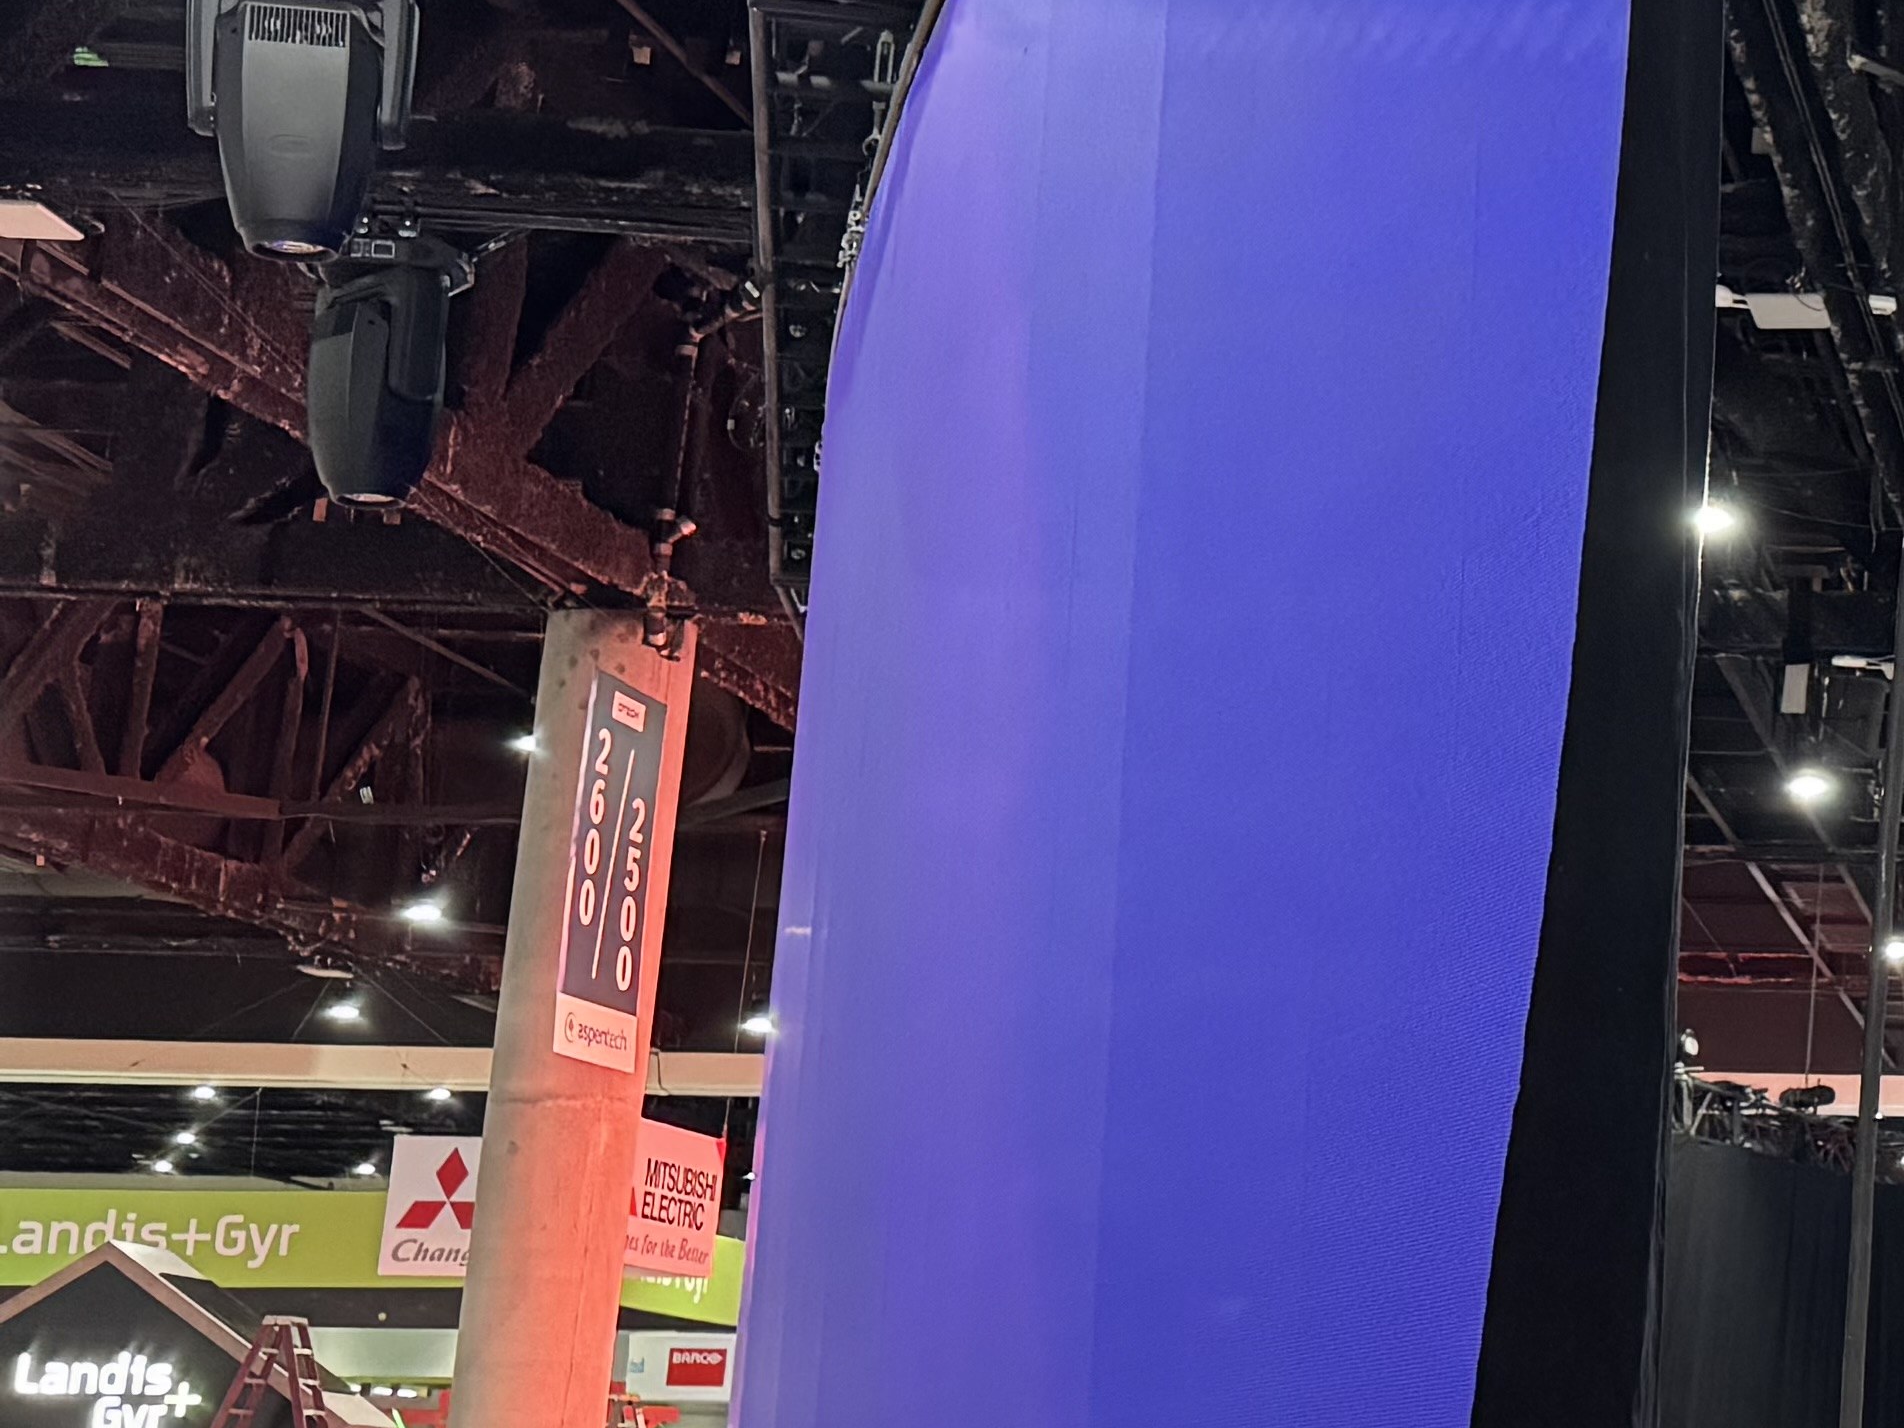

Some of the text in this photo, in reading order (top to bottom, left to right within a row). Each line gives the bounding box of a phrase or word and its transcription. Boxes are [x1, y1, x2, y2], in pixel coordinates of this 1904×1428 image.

[579, 728, 612, 926] 2600
[616, 798, 646, 992] 2500
[645, 1157, 718, 1203] MITSUBISHI
[641, 1191, 706, 1232] ELECTRIC
[0, 1208, 300, 1269] andis+Gyr
[391, 1238, 471, 1267] Chang
[640, 1234, 658, 1256] for
[660, 1236, 676, 1258] the
[678, 1237, 708, 1265] Better
[14, 1350, 173, 1396] Landis
[672, 1351, 724, 1365] BARCO
